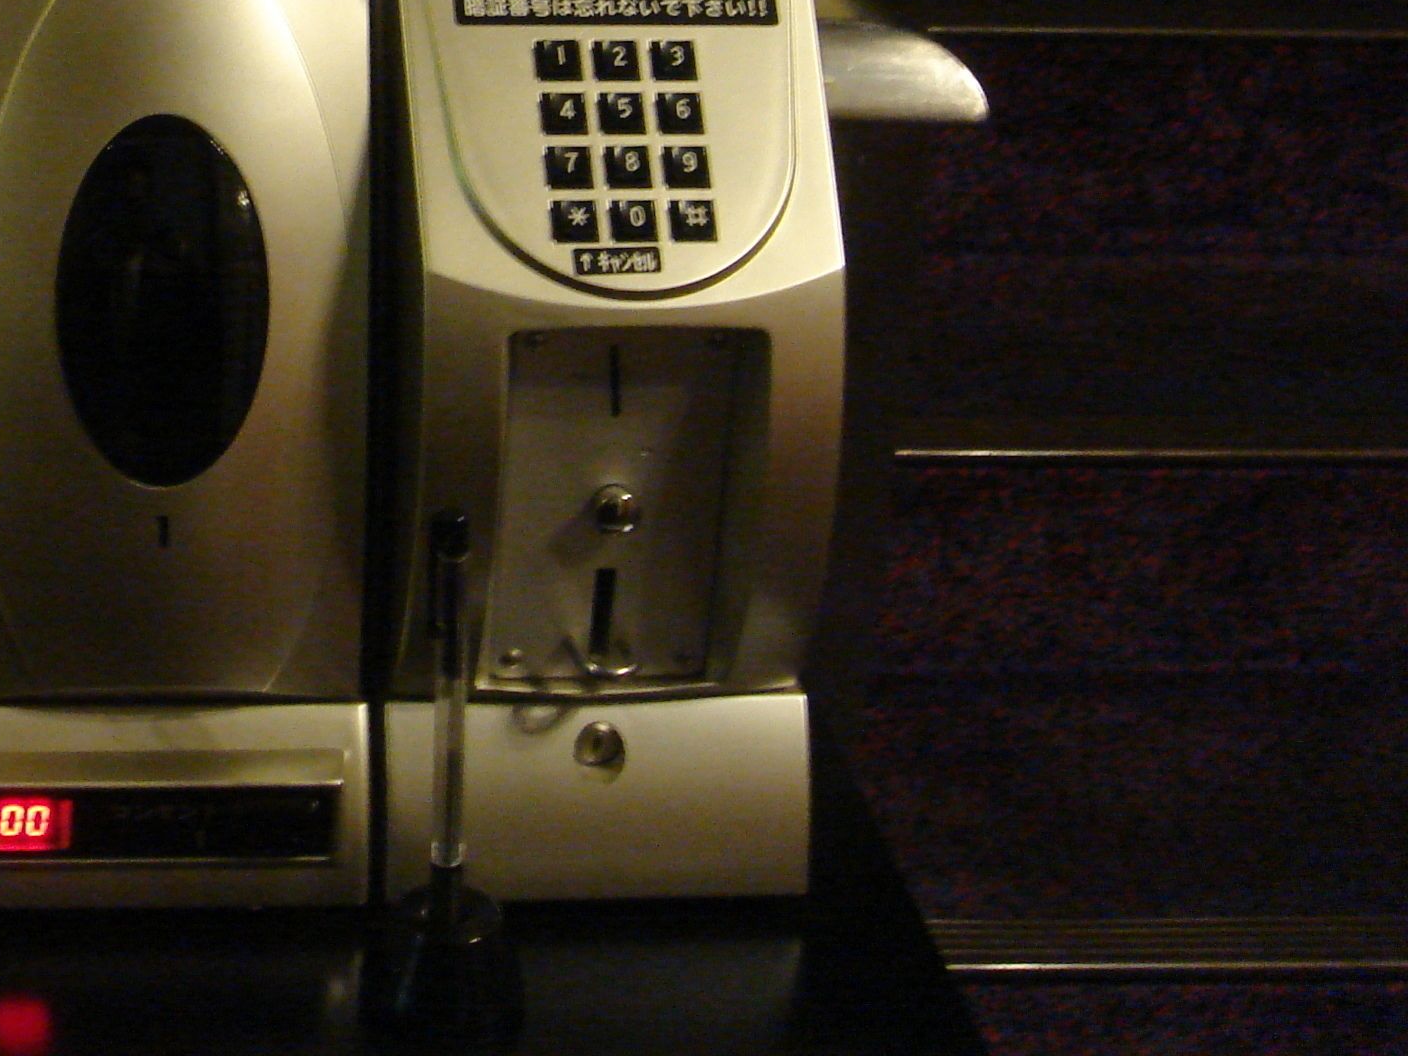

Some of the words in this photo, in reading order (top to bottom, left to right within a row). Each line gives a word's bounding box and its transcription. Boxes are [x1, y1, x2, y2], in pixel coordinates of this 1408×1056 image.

[556, 45, 566, 66] 1
[611, 46, 628, 67] 2
[670, 46, 685, 67] 3
[559, 99, 575, 119] 4
[617, 98, 632, 119] 5
[675, 98, 691, 119] 6
[564, 152, 578, 173] 7
[624, 151, 640, 171] 8
[683, 151, 698, 172] 9
[630, 207, 645, 227] 0
[156, 515, 169, 546] 1
